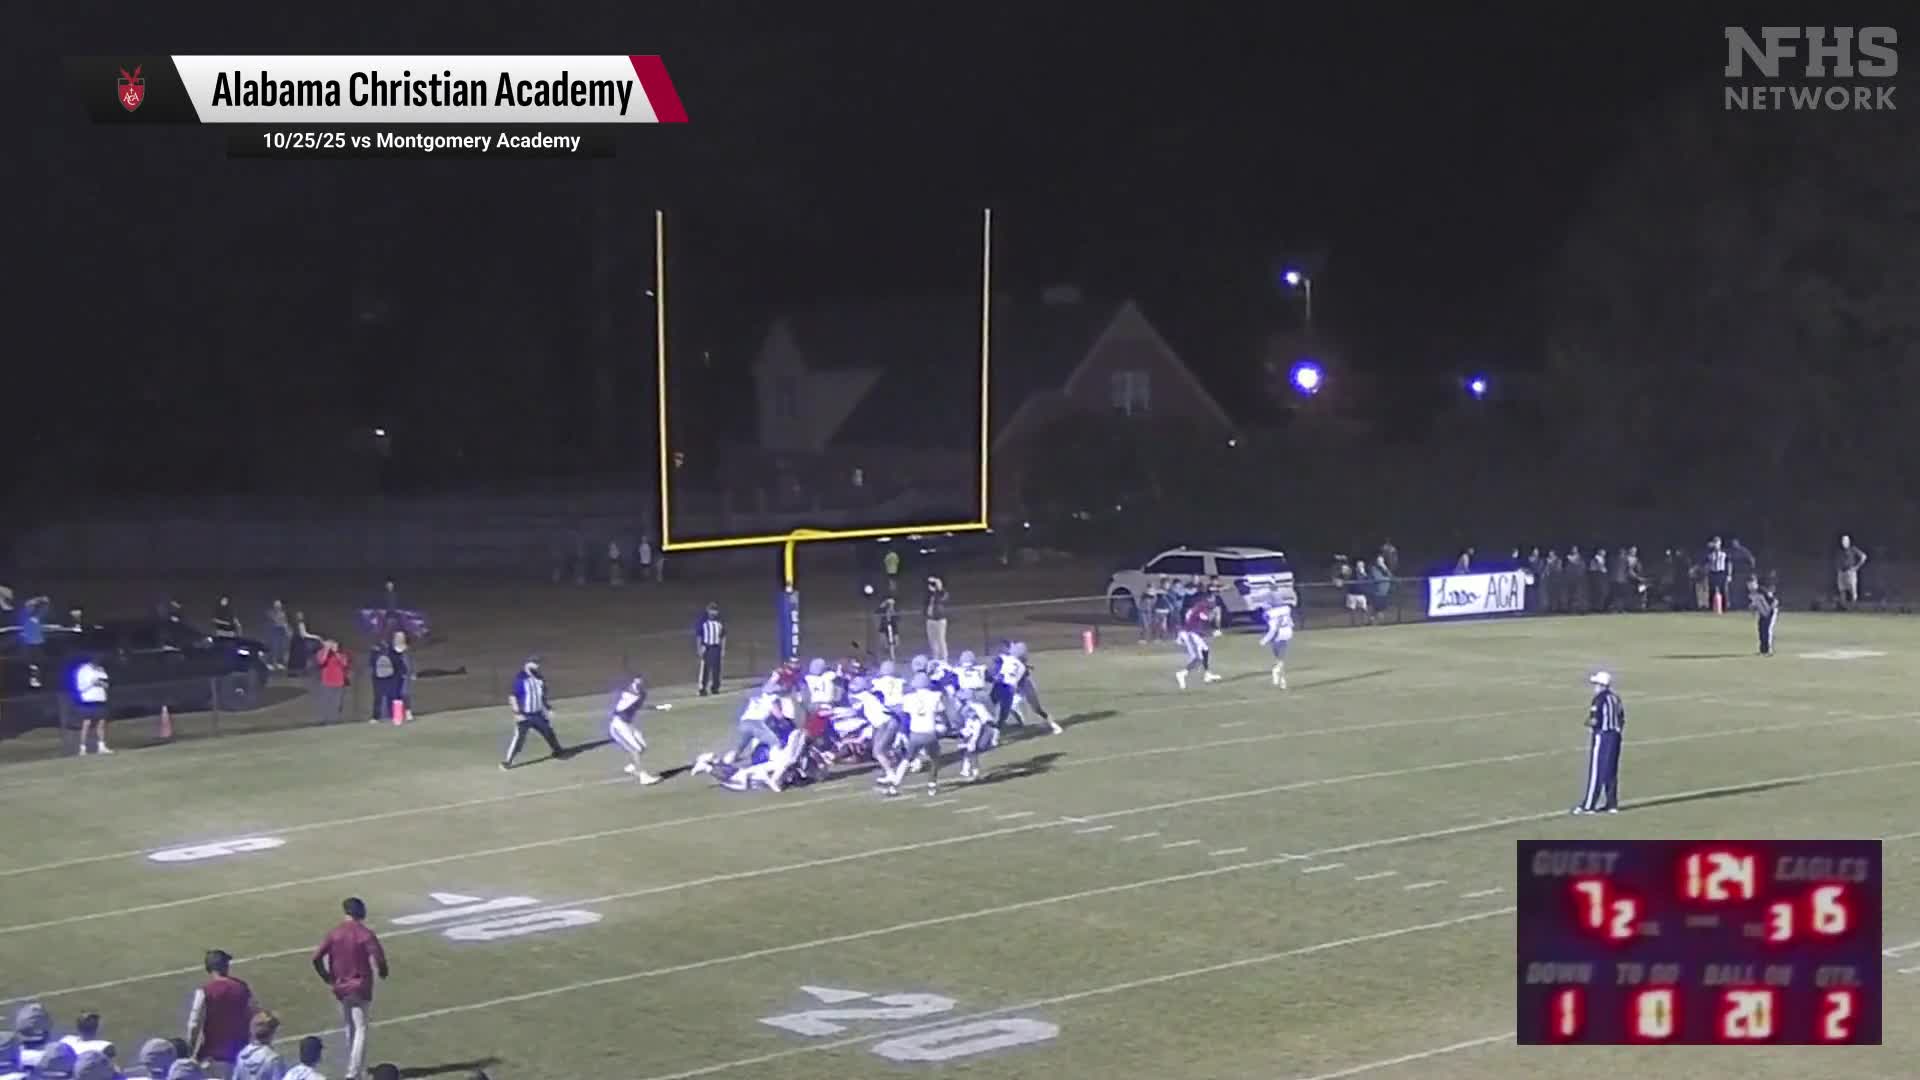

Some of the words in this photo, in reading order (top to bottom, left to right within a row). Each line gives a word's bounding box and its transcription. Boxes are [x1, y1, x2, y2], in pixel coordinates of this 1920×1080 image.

[1485, 574, 1519, 608] ACA
[1532, 850, 1621, 876] GUEST
[1775, 856, 1869, 882] EAGLES
[391, 896, 604, 941] 10
[1575, 880, 1604, 928] 7
[1611, 899, 1636, 939] 2
[1768, 903, 1793, 941] 3
[1813, 885, 1847, 934] 6
[1526, 962, 1594, 985] DOWN
[1703, 964, 1757, 987] BALL
[758, 992, 1060, 1062] 20
[1561, 990, 1576, 1036] 1
[1637, 990, 1674, 1038] 10
[1724, 990, 1774, 1039] 20
[1825, 992, 1851, 1039] 2
